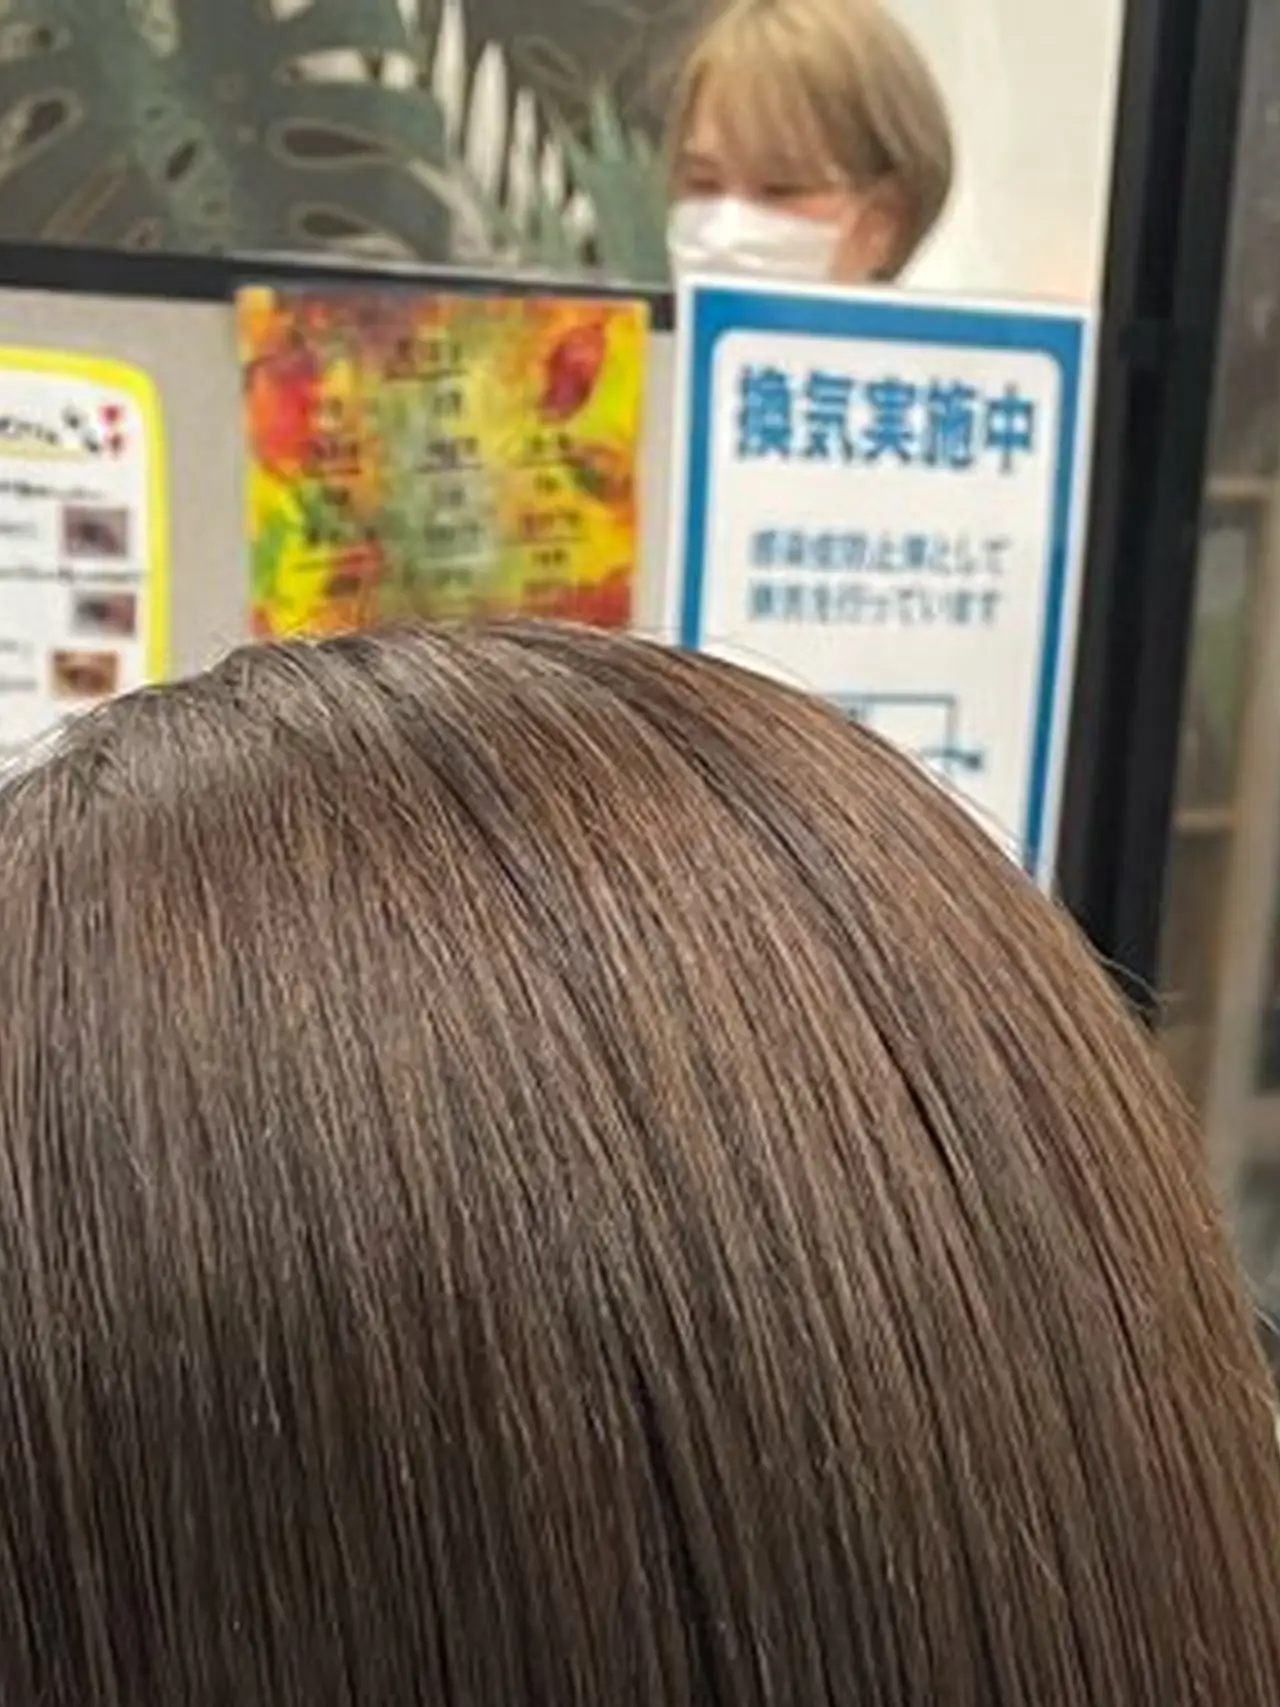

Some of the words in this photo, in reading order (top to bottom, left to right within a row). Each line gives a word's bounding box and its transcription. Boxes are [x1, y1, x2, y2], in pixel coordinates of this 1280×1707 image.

[736, 363, 1037, 474] 換気実施中
